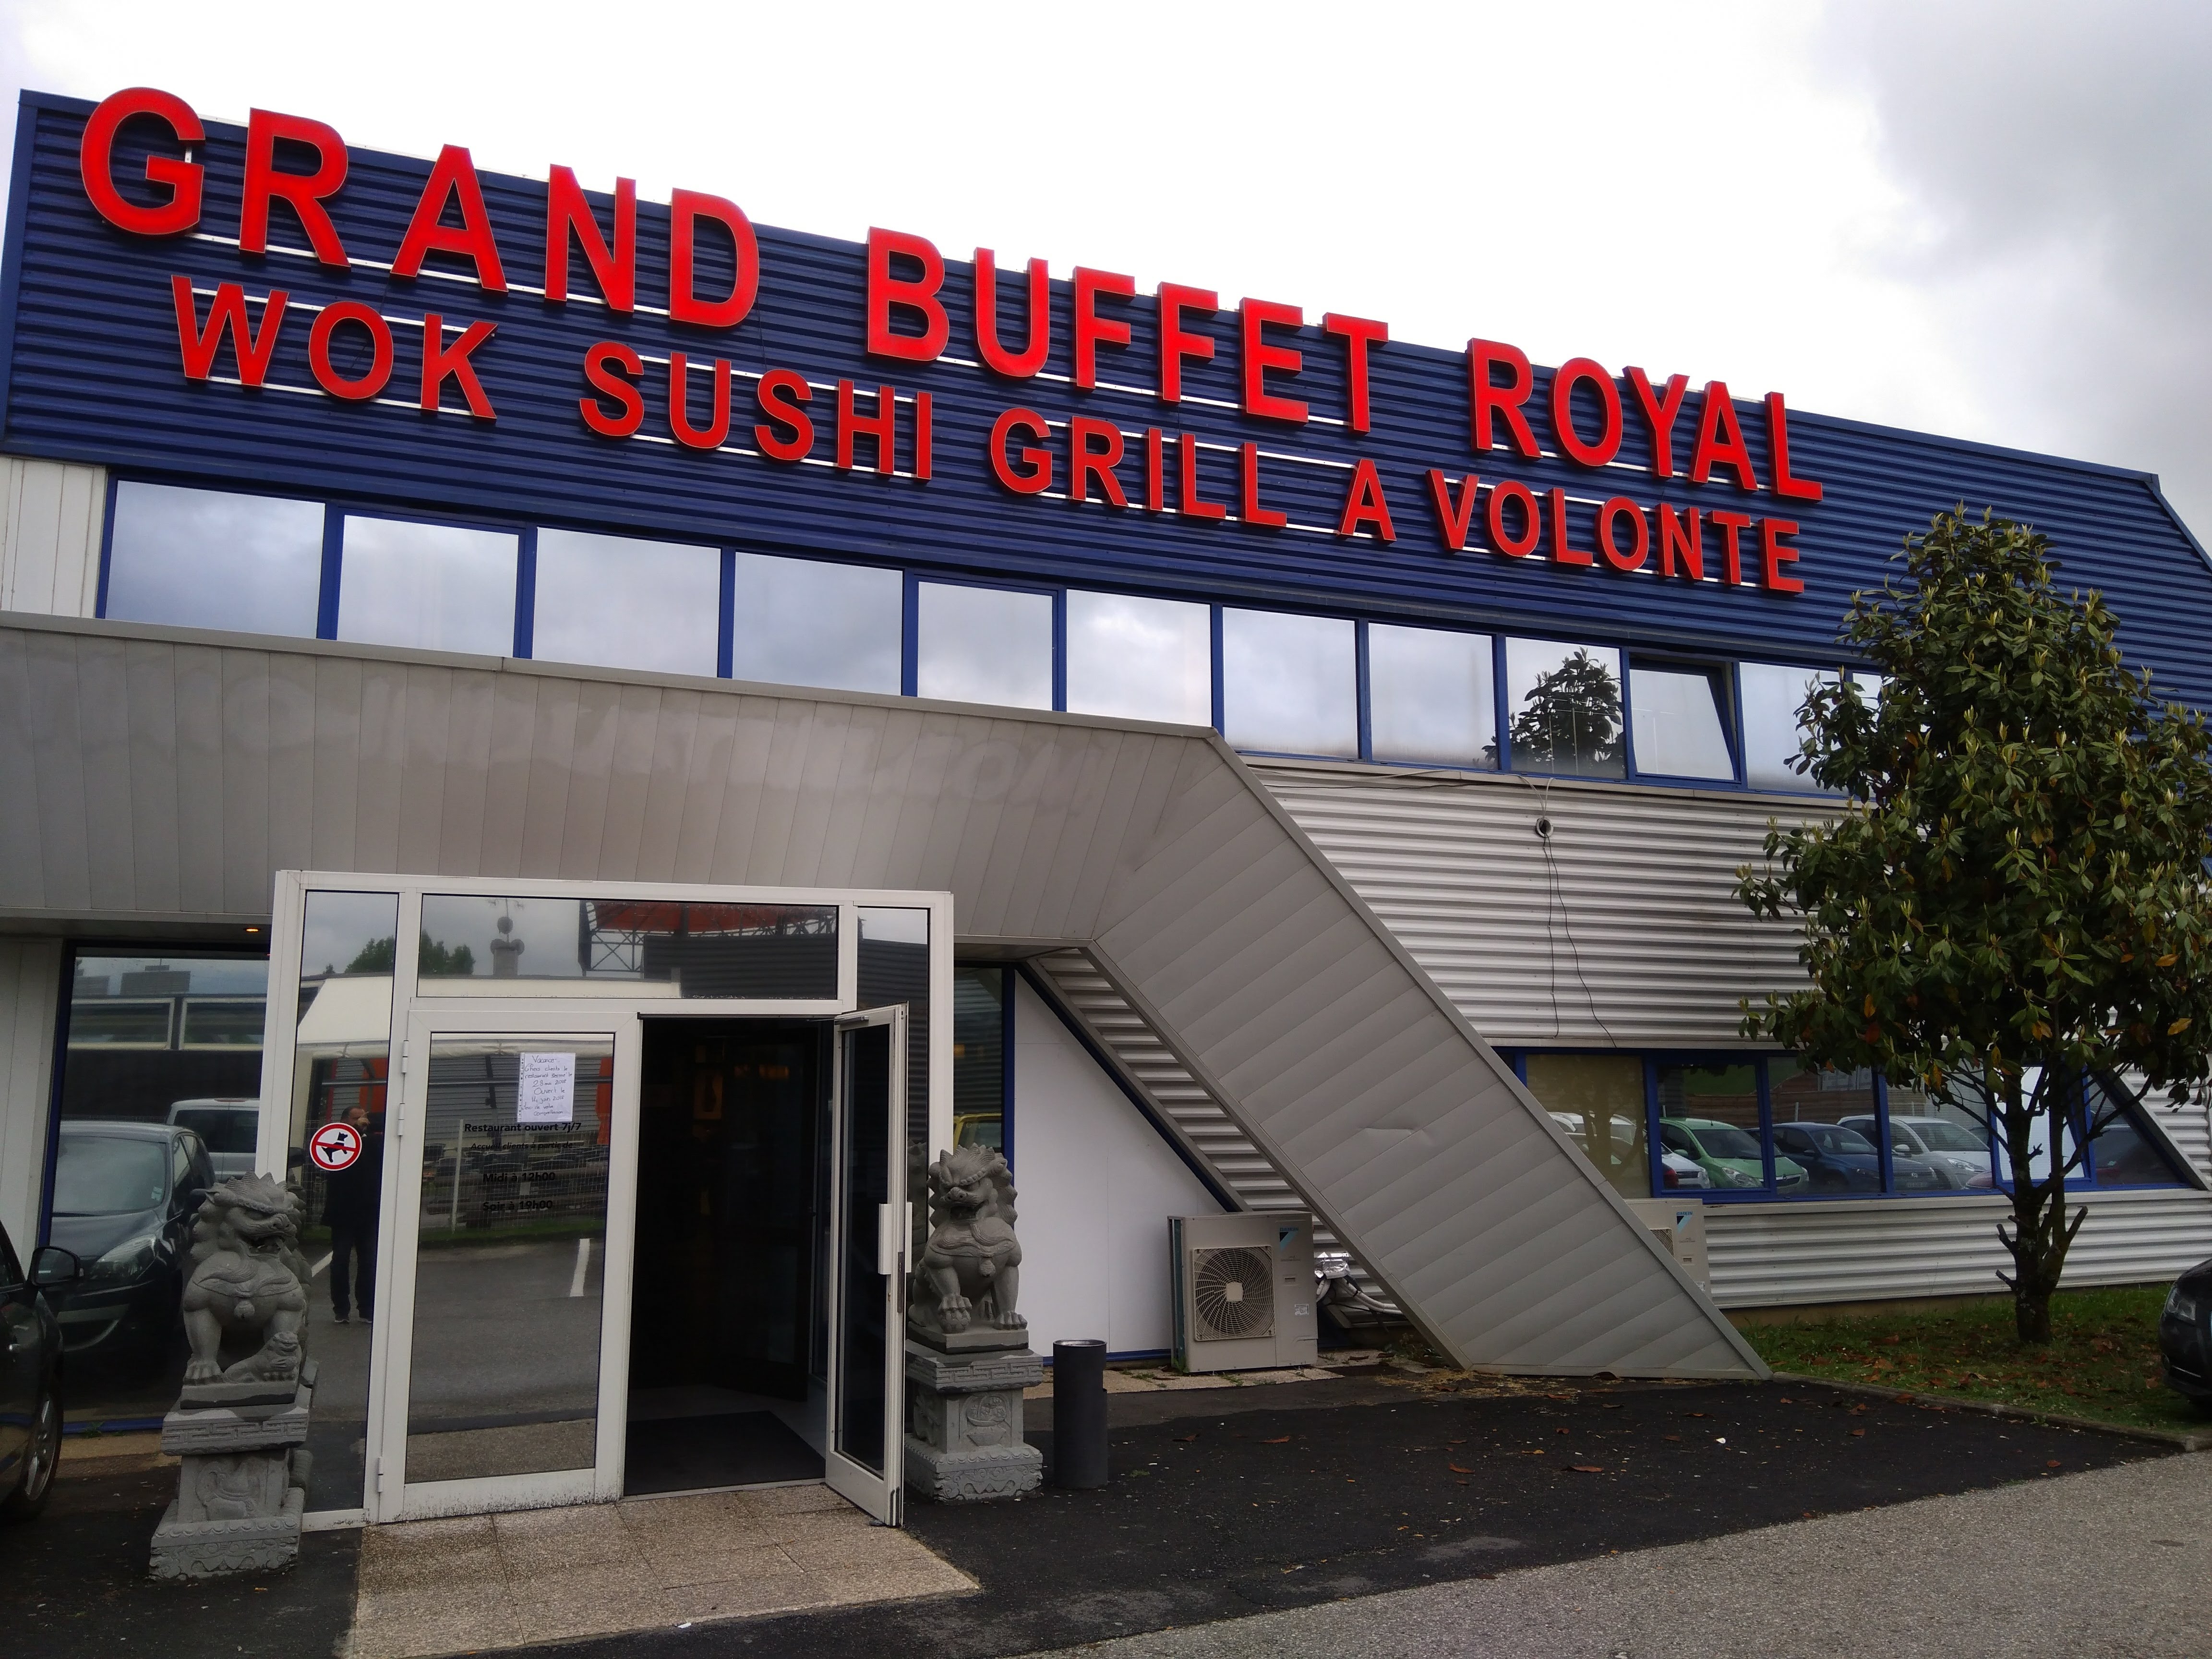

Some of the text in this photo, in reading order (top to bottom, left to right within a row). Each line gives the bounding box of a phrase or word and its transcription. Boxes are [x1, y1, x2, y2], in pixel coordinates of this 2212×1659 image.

[80, 88, 1824, 502] GRAND BUFFET ROYAL
[171, 275, 1805, 595] WOK SUSHI GRILL A VOLONTE
[465, 1122, 582, 1133] Restaurant ouvert 7j/7
[537, 1142, 562, 1150] partir
[482, 1172, 556, 1183] Midi à 12h00
[482, 1200, 553, 1211] Soir à 19h00
